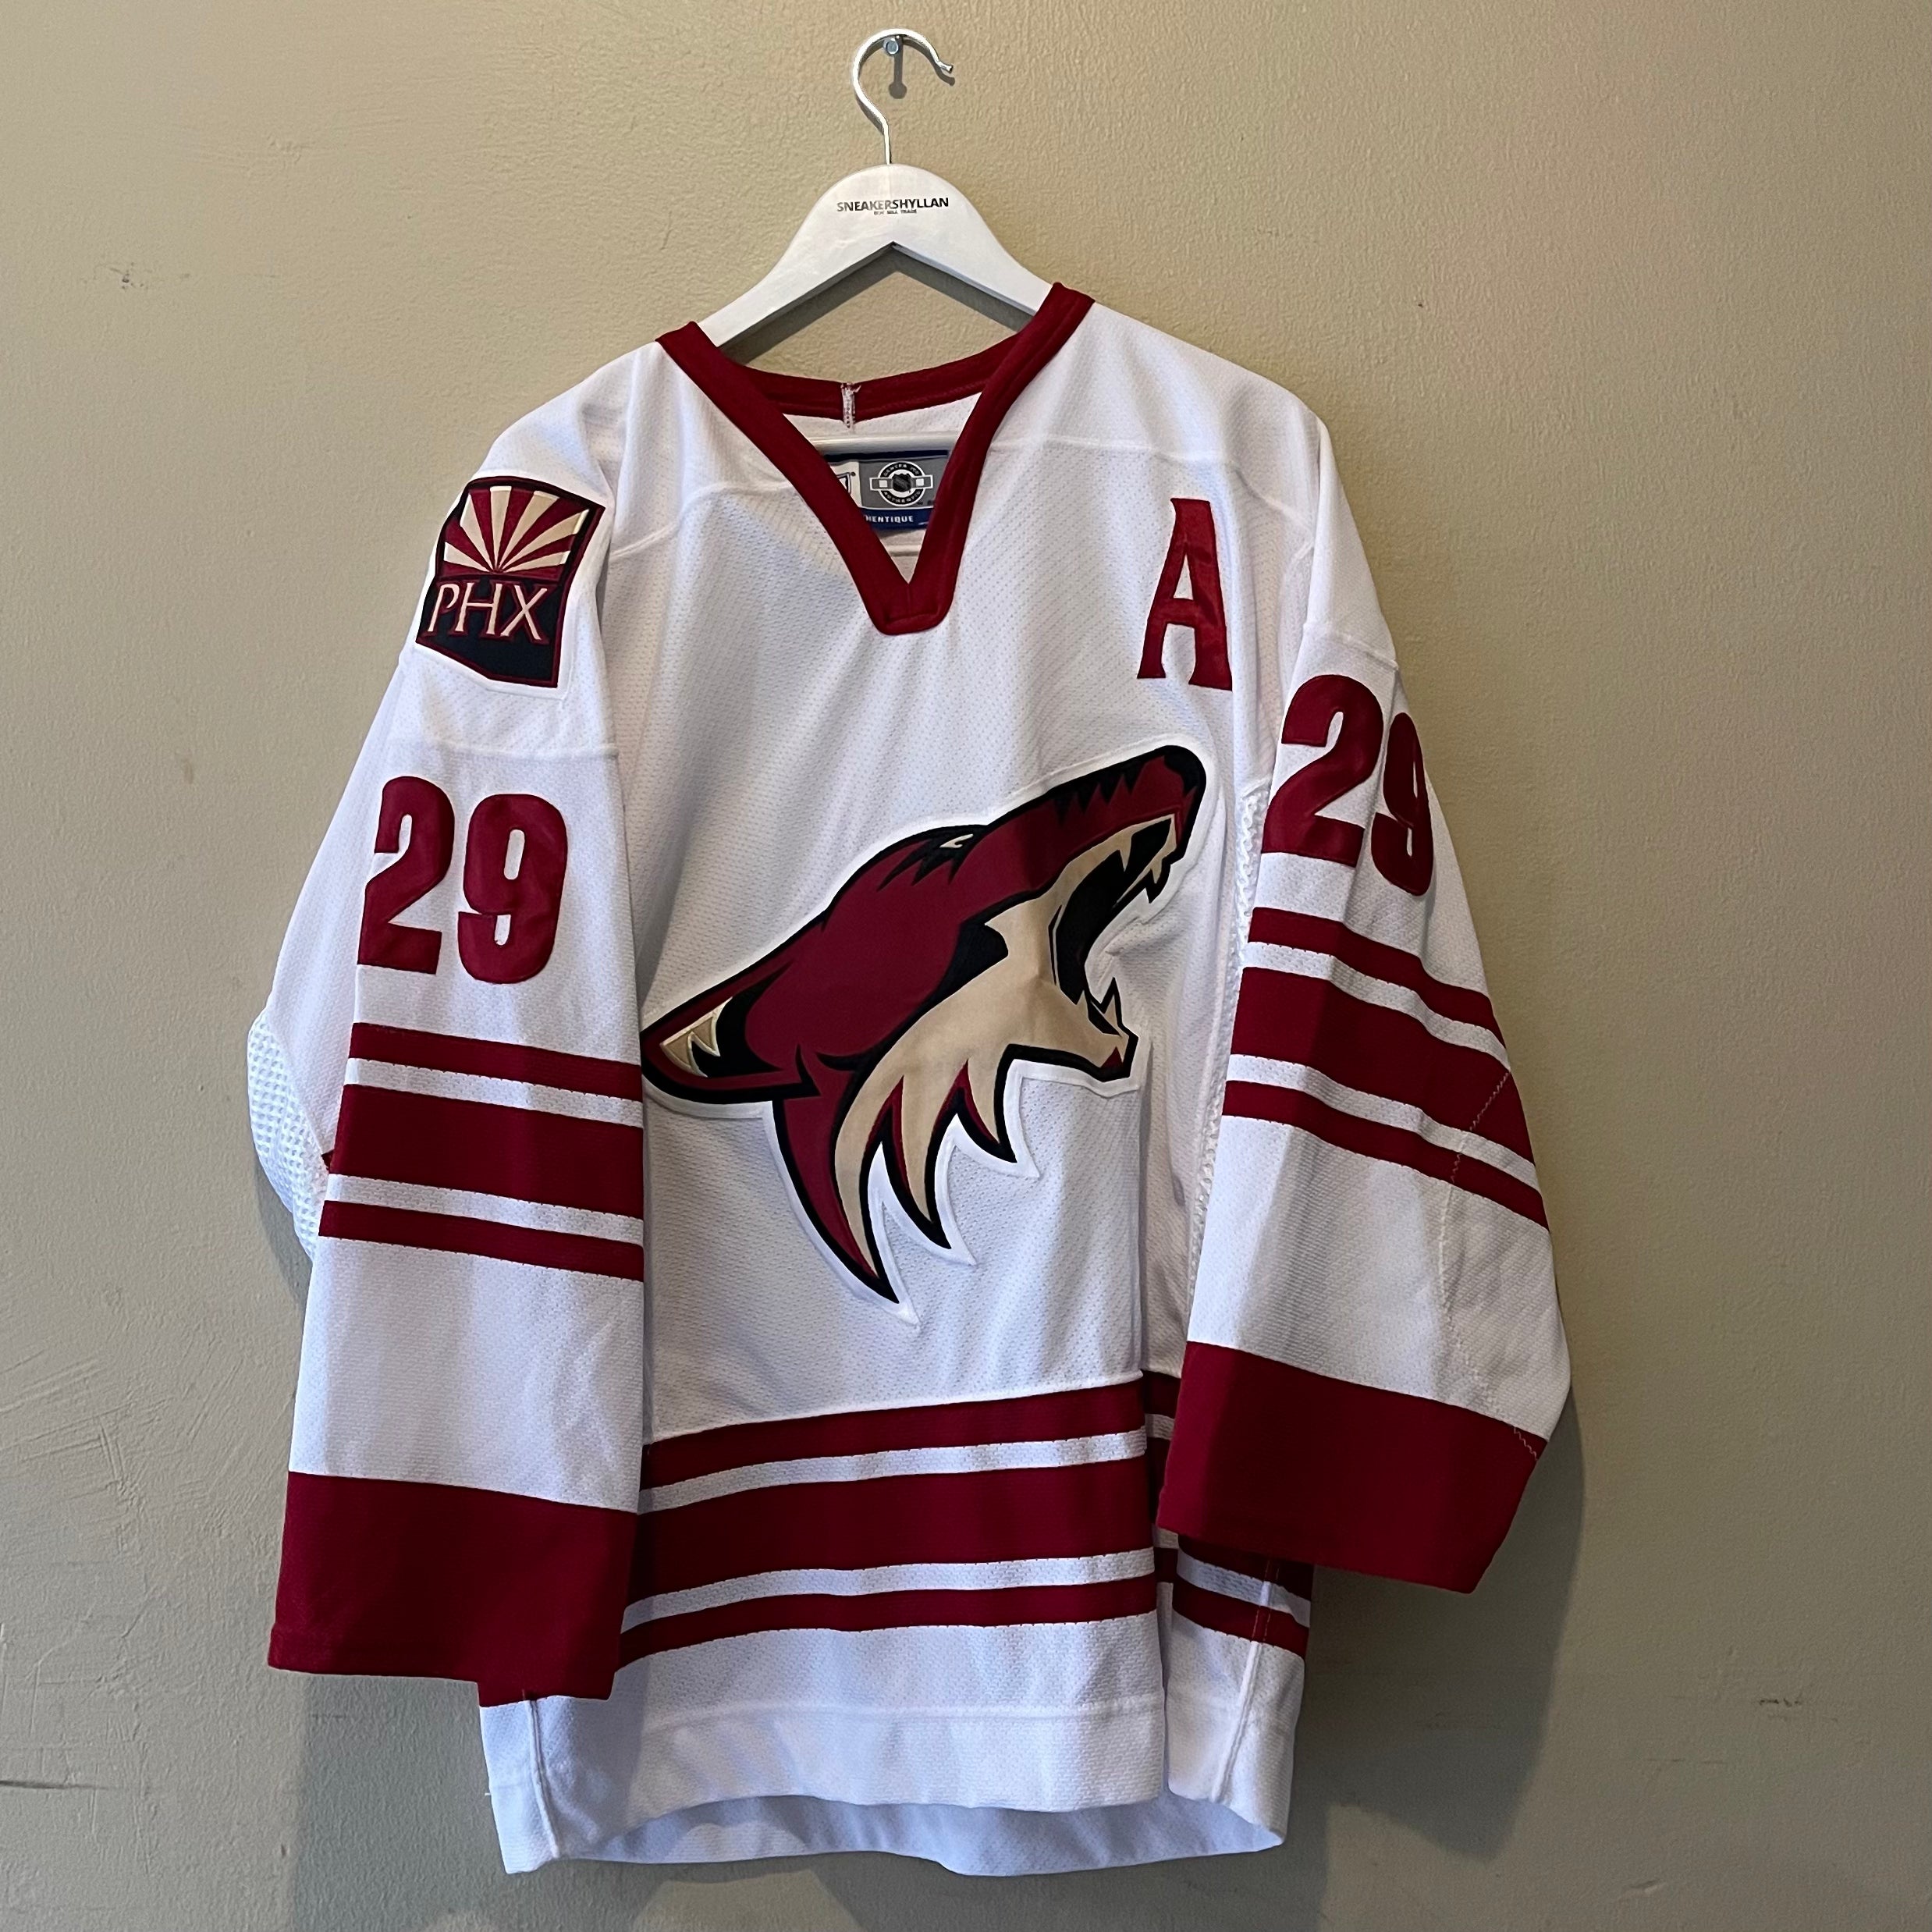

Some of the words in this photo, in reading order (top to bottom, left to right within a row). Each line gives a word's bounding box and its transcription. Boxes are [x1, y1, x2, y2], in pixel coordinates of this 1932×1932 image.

[836, 197, 949, 212] SNEAKERSHYLLAN
[426, 581, 548, 641] PHX
[1137, 498, 1233, 691] A
[357, 776, 568, 985] 29
[1261, 674, 1434, 897] 29
